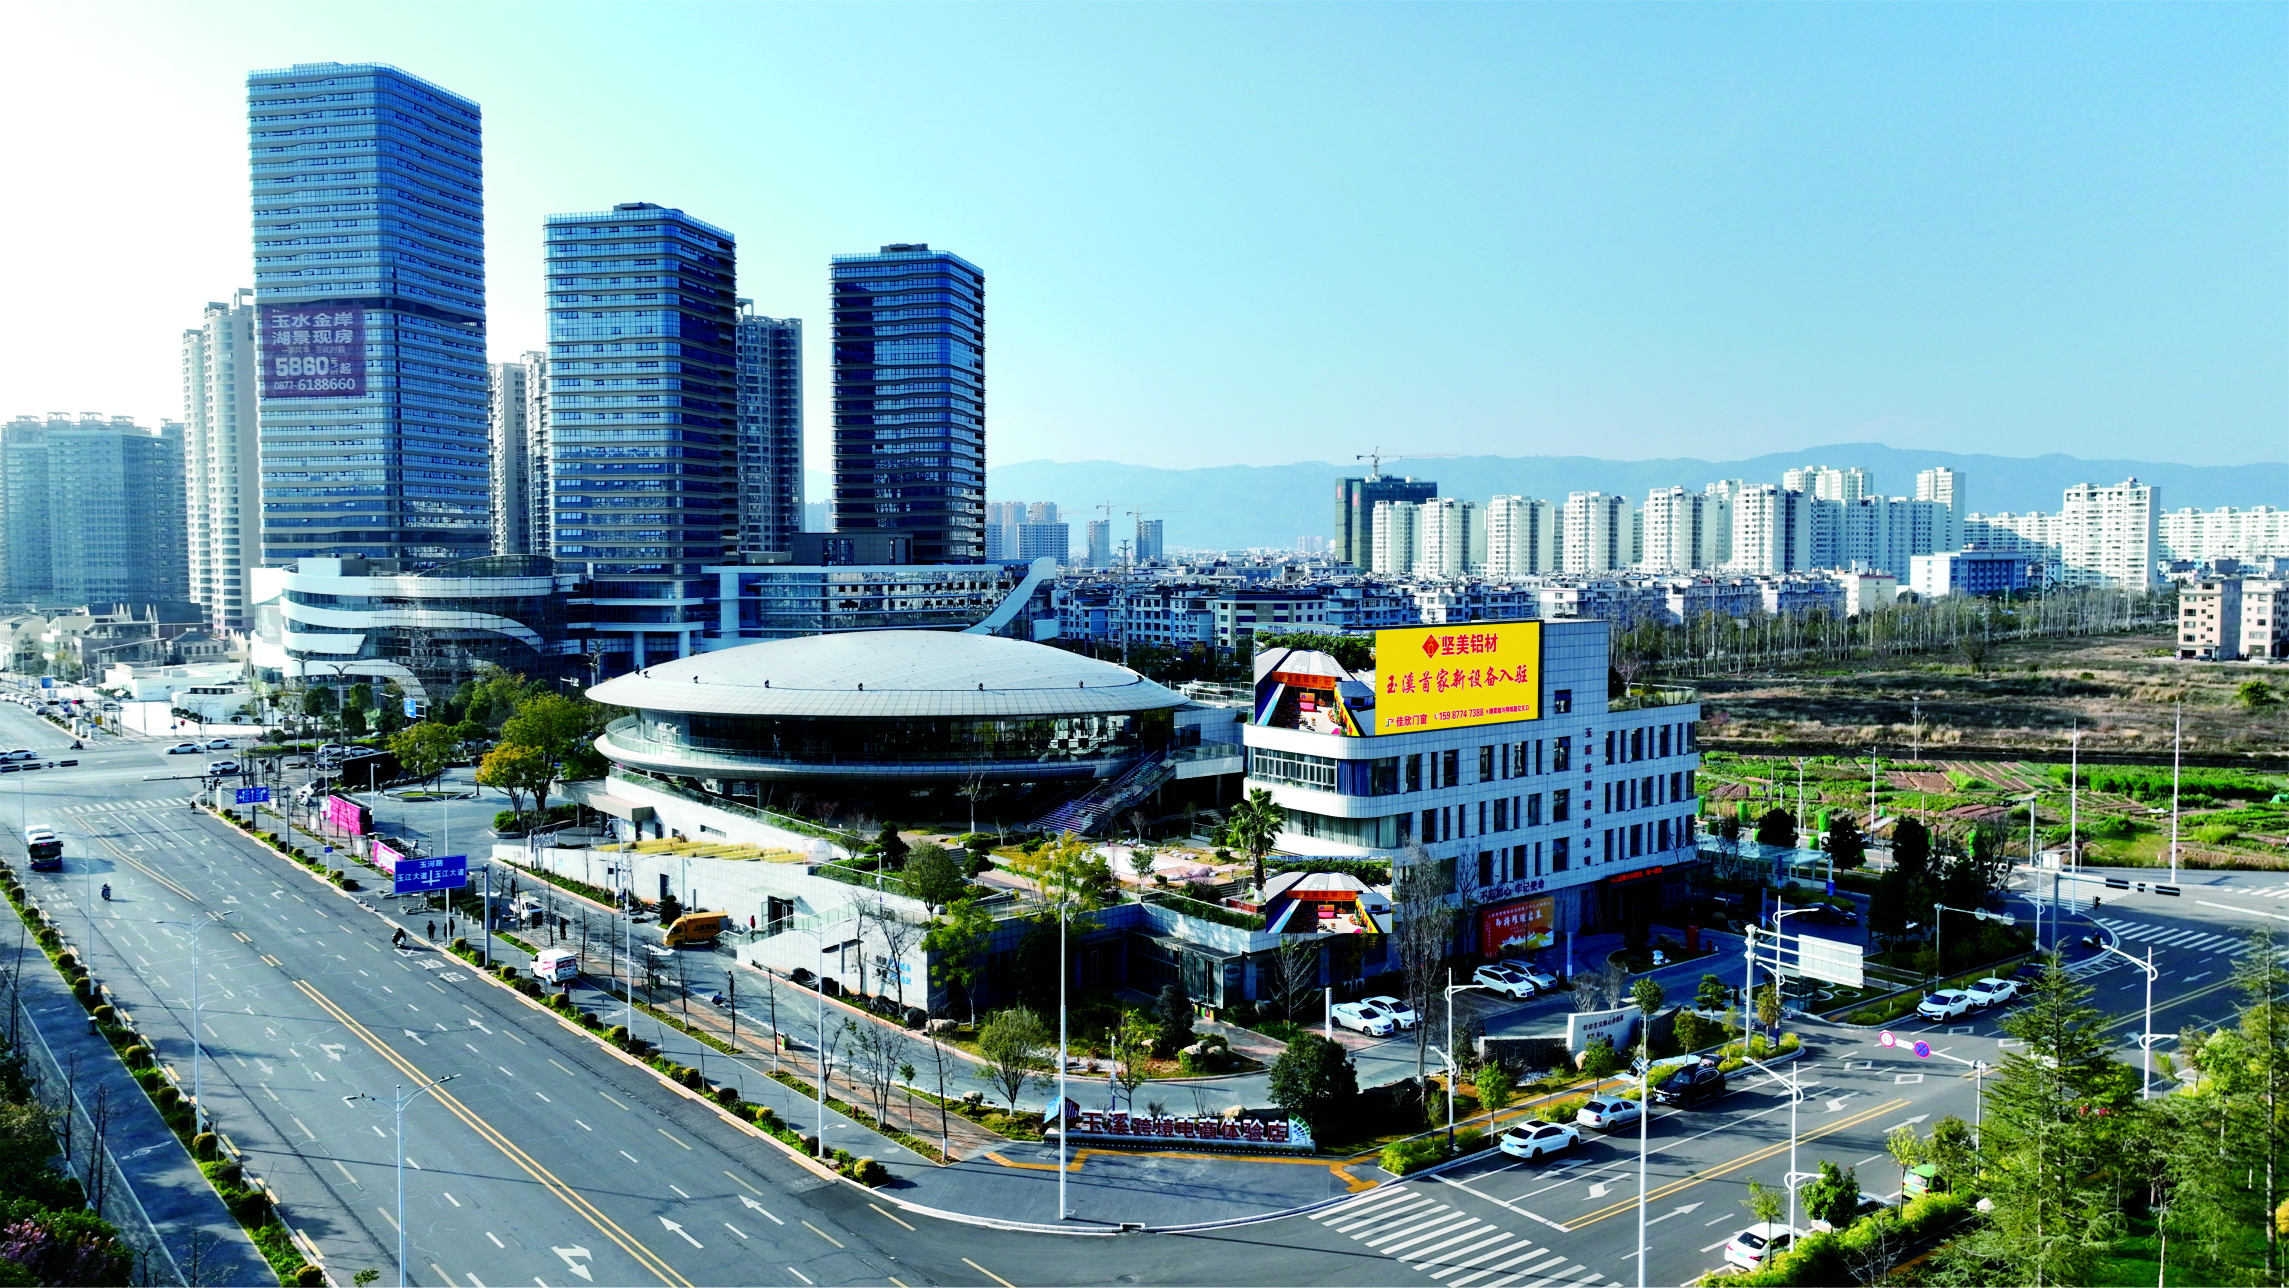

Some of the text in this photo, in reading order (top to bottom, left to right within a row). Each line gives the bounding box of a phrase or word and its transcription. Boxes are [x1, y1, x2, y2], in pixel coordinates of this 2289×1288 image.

[271, 312, 354, 329] 玉水金岸
[271, 328, 354, 346] 湖景现房
[275, 356, 329, 377] 5860
[273, 377, 356, 391] 0877-6188660
[1441, 632, 1499, 656] 坚美铝材
[1386, 664, 1528, 694] 玉溪首家新设备入驻
[1396, 713, 1428, 728] 佳欣门窗
[1439, 711, 1451, 721] 159
[1452, 709, 1467, 720] 8774
[419, 859, 443, 868] 玉河路
[397, 868, 464, 882] 玉江大道 玉江大道
[1515, 878, 1545, 894] 牢记使命
[1081, 1109, 1289, 1143] 玉溪跨境电商体验店
